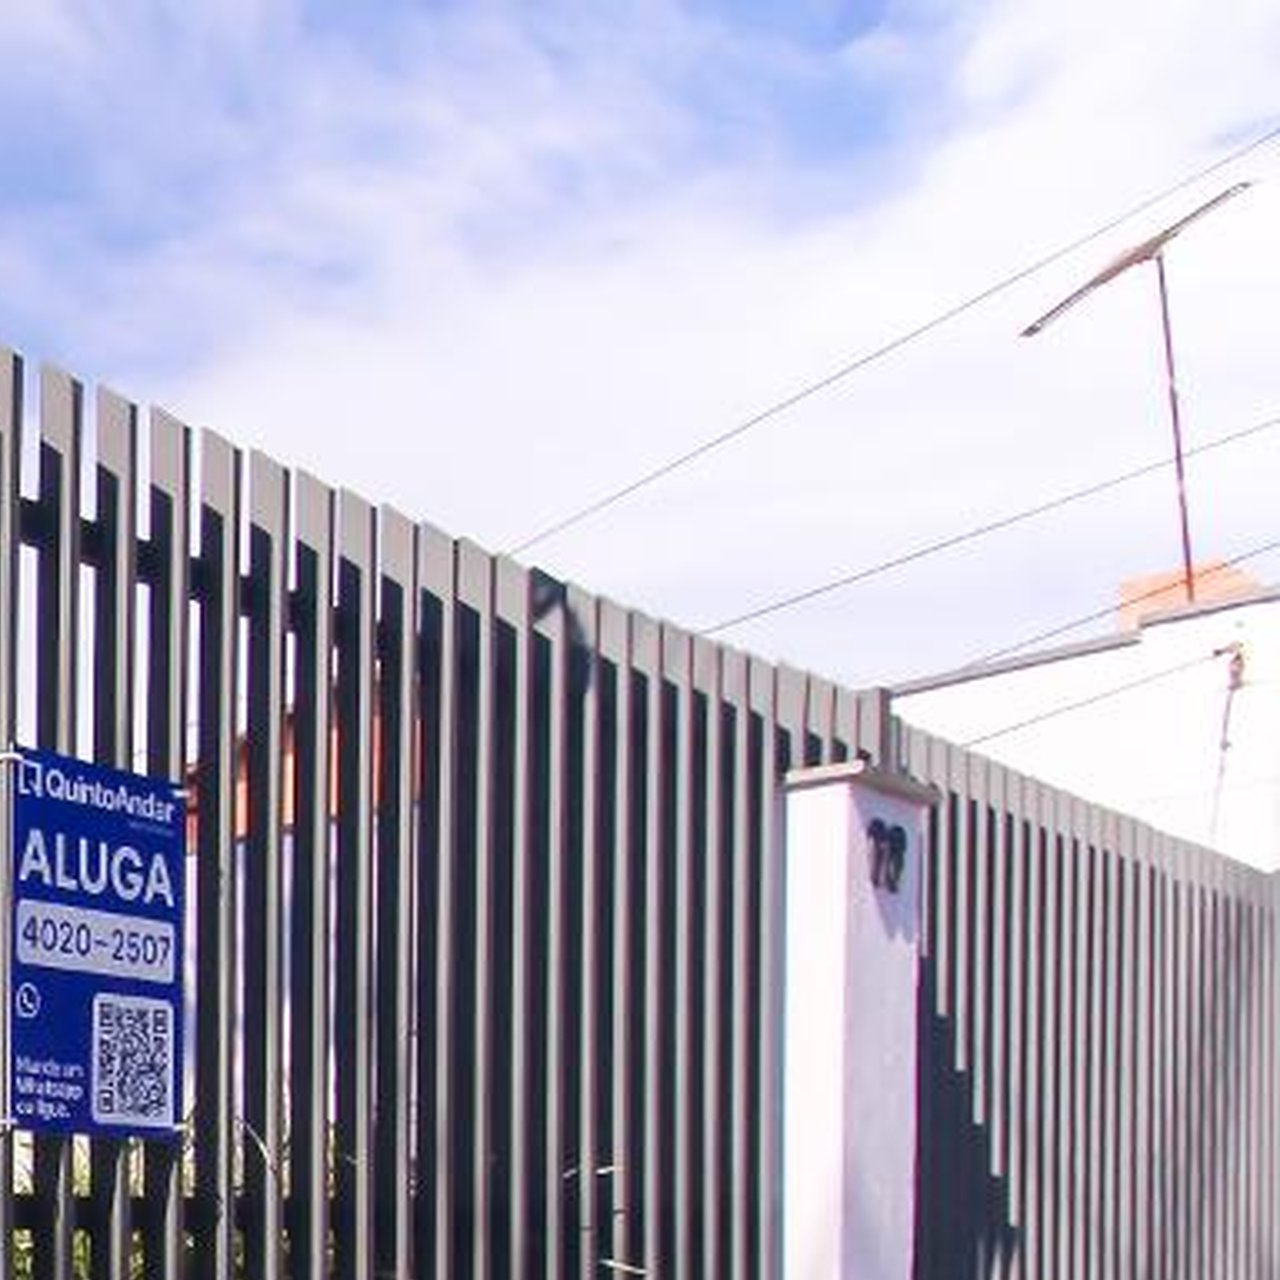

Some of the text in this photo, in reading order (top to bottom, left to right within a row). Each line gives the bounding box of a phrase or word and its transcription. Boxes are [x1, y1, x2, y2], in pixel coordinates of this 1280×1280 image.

[45, 768, 176, 823] QuintoAndar
[19, 828, 175, 908] ALUGA
[21, 915, 171, 967] 4020-2507
